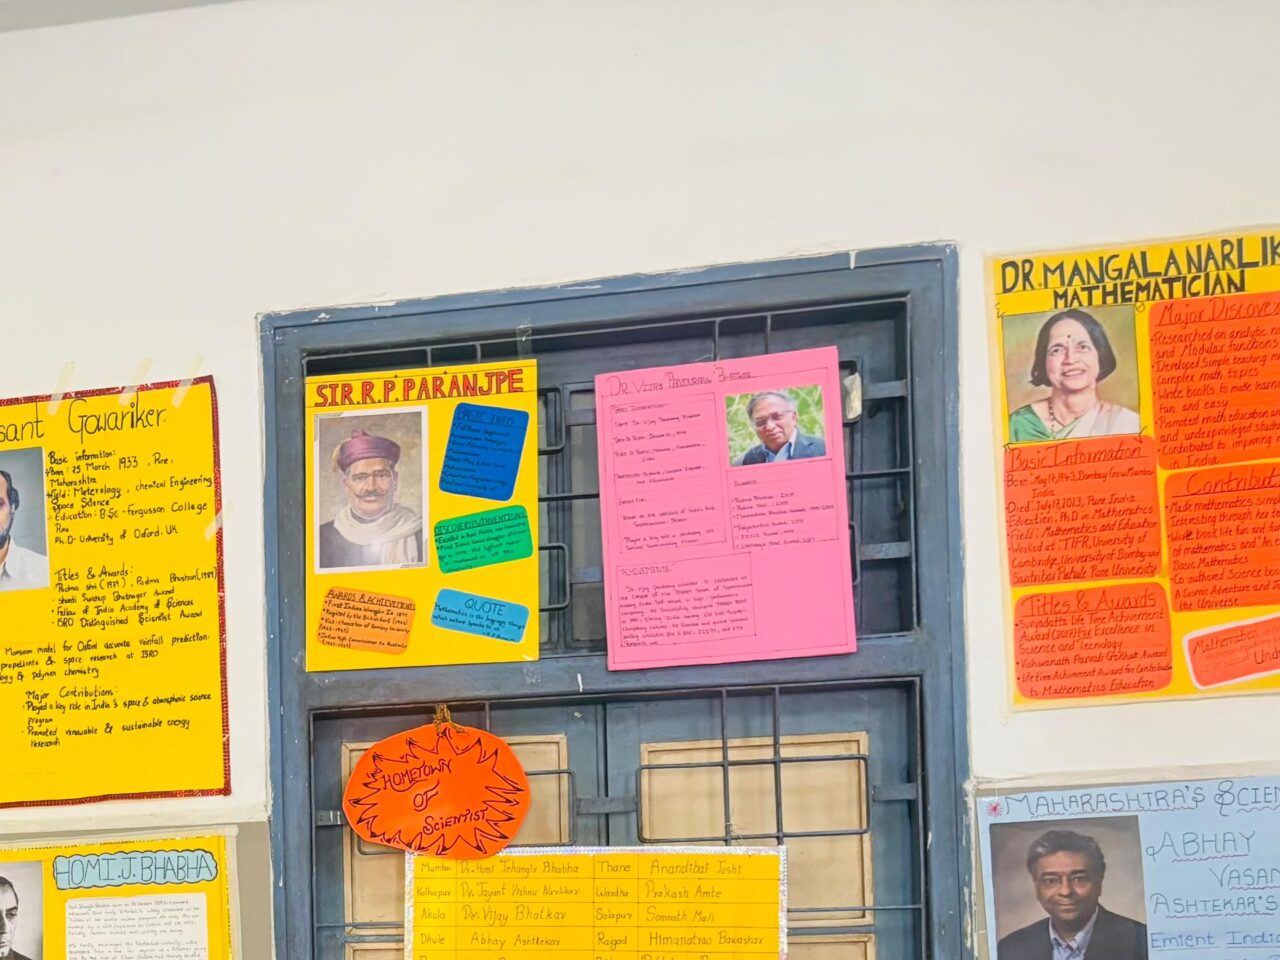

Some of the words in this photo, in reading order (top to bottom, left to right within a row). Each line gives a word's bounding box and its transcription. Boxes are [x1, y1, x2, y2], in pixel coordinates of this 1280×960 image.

[1053, 270, 1245, 309] MATHEMATICIAN
[1158, 303, 1203, 329] Major
[48, 451, 68, 465] Basic
[86, 462, 110, 470] March
[119, 456, 138, 470] 1933
[1010, 448, 1046, 471] Basic
[1047, 443, 1141, 466] Information
[170, 475, 212, 490] Engineering
[171, 501, 208, 514] College
[54, 568, 79, 581] Titles
[465, 598, 505, 616] QUOTE
[1076, 590, 1088, 610] &
[1096, 589, 1156, 609] Awards
[25, 691, 50, 703] Major
[381, 759, 453, 792] HOMETOWN
[1005, 786, 1205, 816] MAHARASHTRA'S
[1146, 830, 1256, 861] ABHAY
[141, 854, 213, 884] BHABHA
[598, 860, 631, 873] Thane
[1151, 932, 1216, 949] Emient
